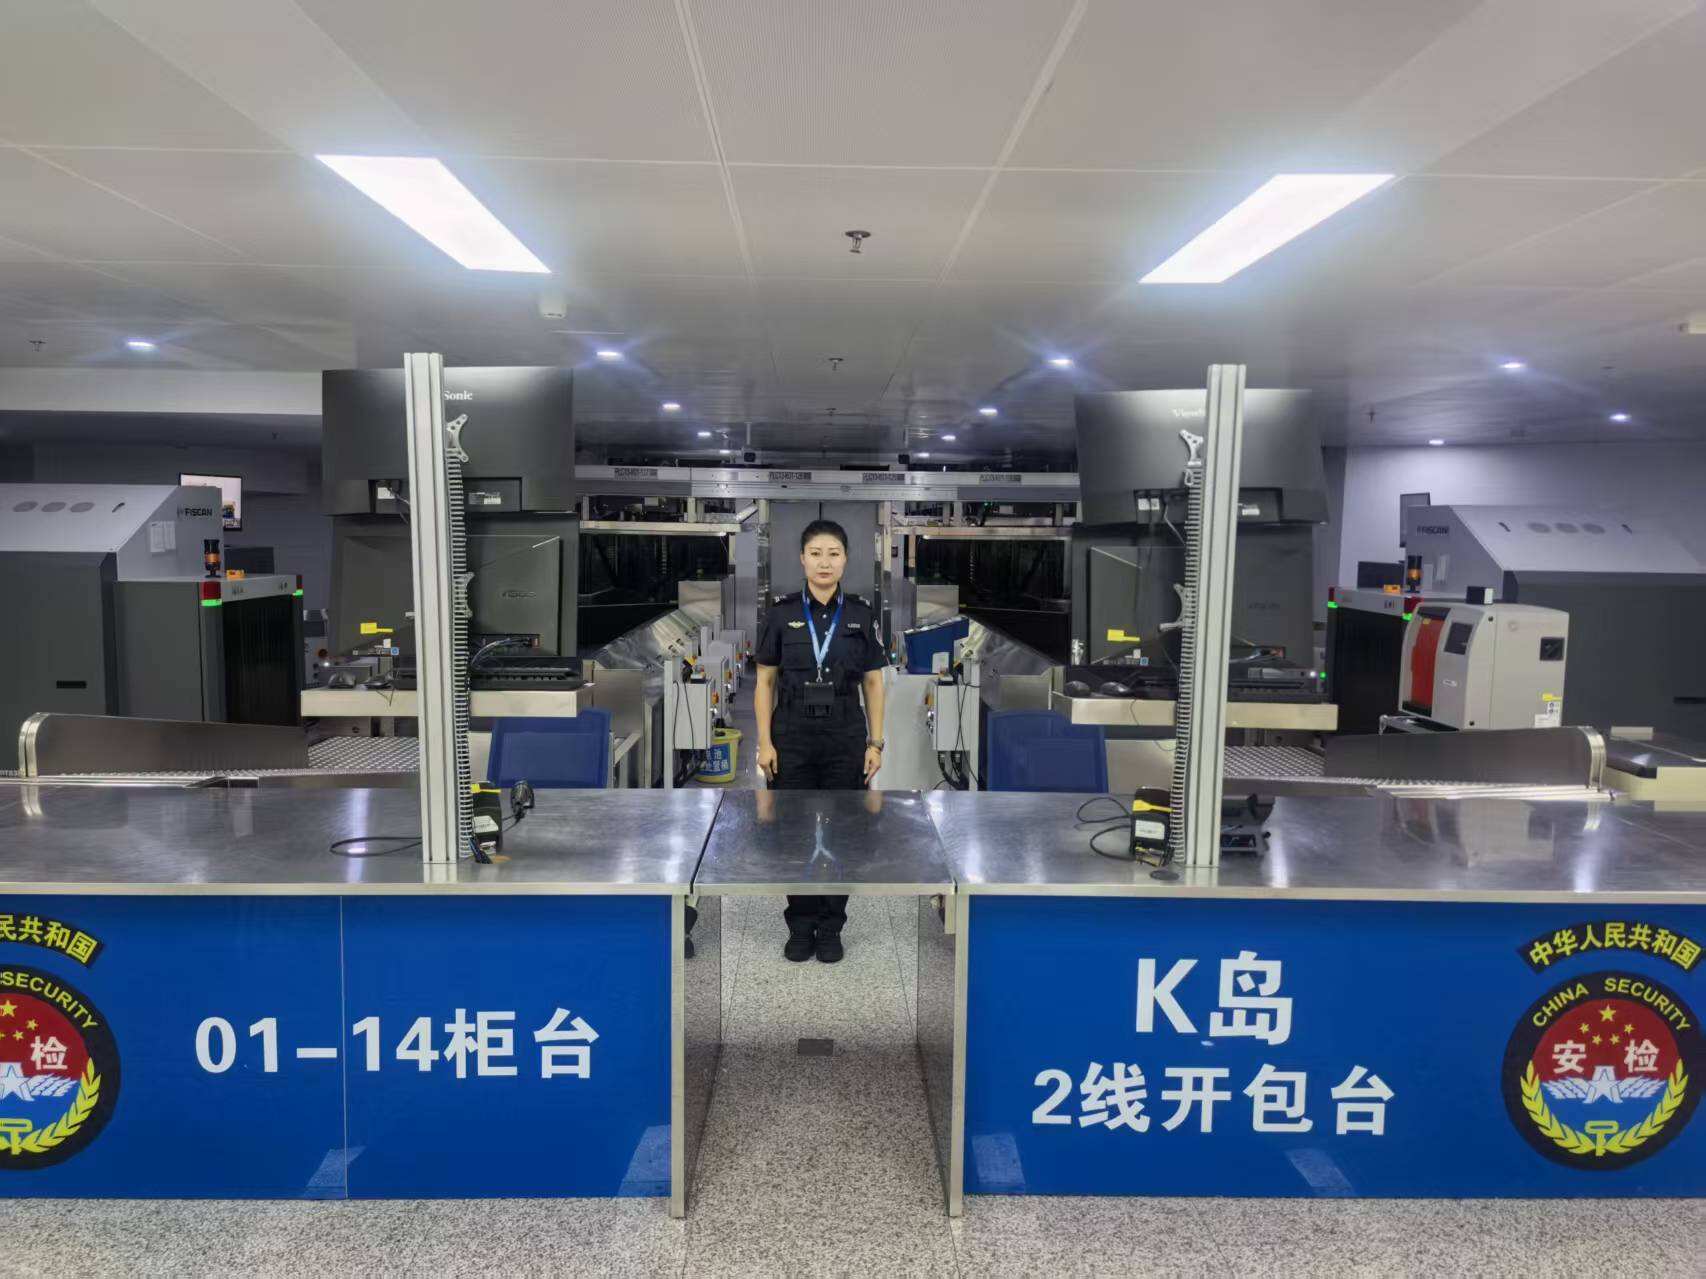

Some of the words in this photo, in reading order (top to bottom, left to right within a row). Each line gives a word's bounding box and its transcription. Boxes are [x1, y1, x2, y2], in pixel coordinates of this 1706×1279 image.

[444, 390, 473, 401] Sonic
[0, 915, 98, 964] 民共和国
[1529, 922, 1701, 970] 中华人民共和国
[1, 971, 98, 1029] SECURITY
[1135, 950, 1294, 1046] K岛
[1532, 983, 1589, 1027] CHINA
[1604, 977, 1691, 1031] SECURITY
[31, 1035, 69, 1071] 检
[1031, 1061, 1395, 1136] 2线开包台
